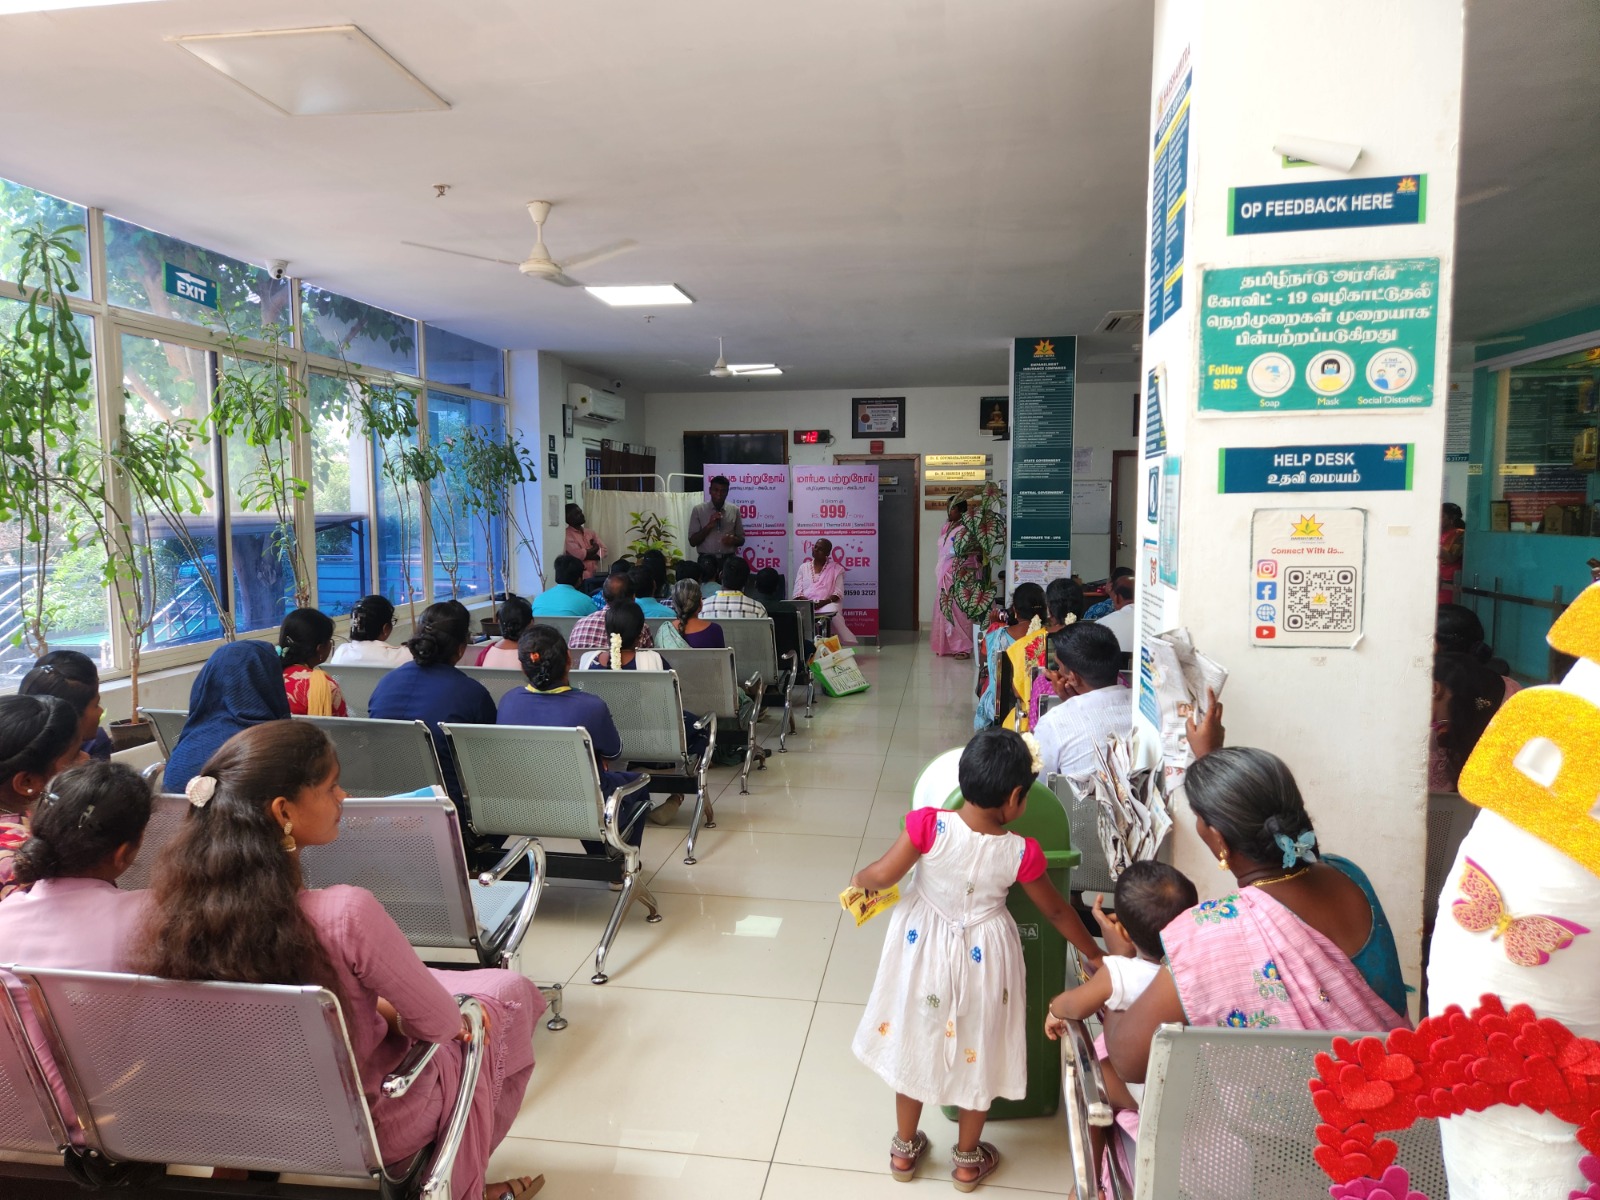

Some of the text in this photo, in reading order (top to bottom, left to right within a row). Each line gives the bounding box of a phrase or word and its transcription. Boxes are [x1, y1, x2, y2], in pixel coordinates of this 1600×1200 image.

[1241, 193, 1394, 219] OP FEEDBACK HERE
[1240, 265, 1398, 290] தமிழ்நாடு அரசின்
[176, 280, 207, 302] EXIT
[1207, 292, 1272, 308] கோவிட்
[1288, 291, 1308, 305] 19
[1311, 282, 1431, 306] வழிகாட்டுதல்
[1206, 307, 1431, 330] நெறிமுறைகள் முறையாக
[1235, 326, 1398, 347] பின்பற்றப்படுகிறது
[1208, 363, 1244, 376] Follow
[1213, 378, 1238, 390] SMS
[1260, 398, 1280, 408] Soap
[1317, 397, 1340, 405] Mask
[1357, 395, 1422, 405] Social Distance
[1273, 452, 1355, 466] HELP DESK
[1267, 469, 1361, 486] உதவி மையம்
[1271, 547, 1304, 555] Connect
